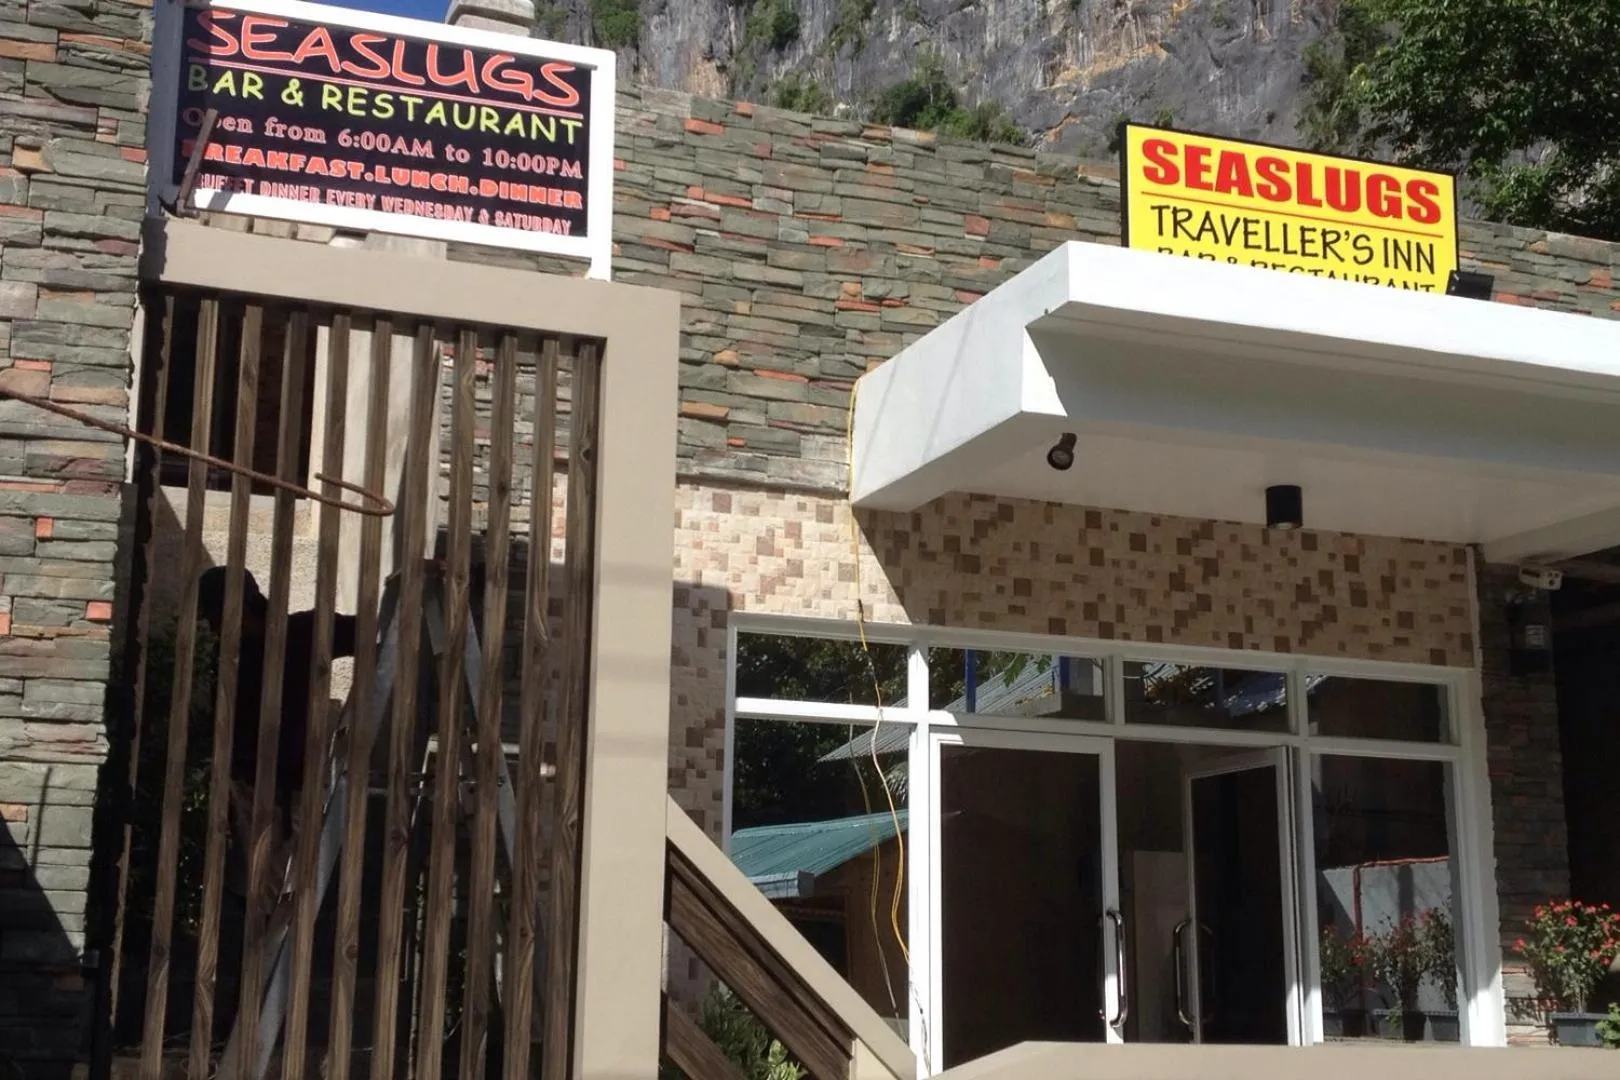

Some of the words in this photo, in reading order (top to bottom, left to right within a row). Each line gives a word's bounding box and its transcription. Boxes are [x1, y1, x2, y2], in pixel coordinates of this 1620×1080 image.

[187, 9, 580, 107] SEASLUGS
[188, 64, 264, 100] BAR
[281, 78, 304, 107] &
[321, 83, 583, 145] RESTAURANT
[182, 107, 253, 134] Oen
[264, 115, 327, 144] from
[337, 128, 435, 159] 6:00AM
[444, 143, 471, 163] to
[482, 147, 583, 179] 10:00PM
[259, 180, 322, 203] DINNER
[326, 188, 376, 211] EVERY
[381, 195, 474, 223] WEDNESDAY
[495, 211, 572, 236] SATURDAY
[1141, 138, 1442, 225] SEASLUGS
[1150, 204, 1374, 265] TRAVELLER'S
[1383, 237, 1435, 275] INN
